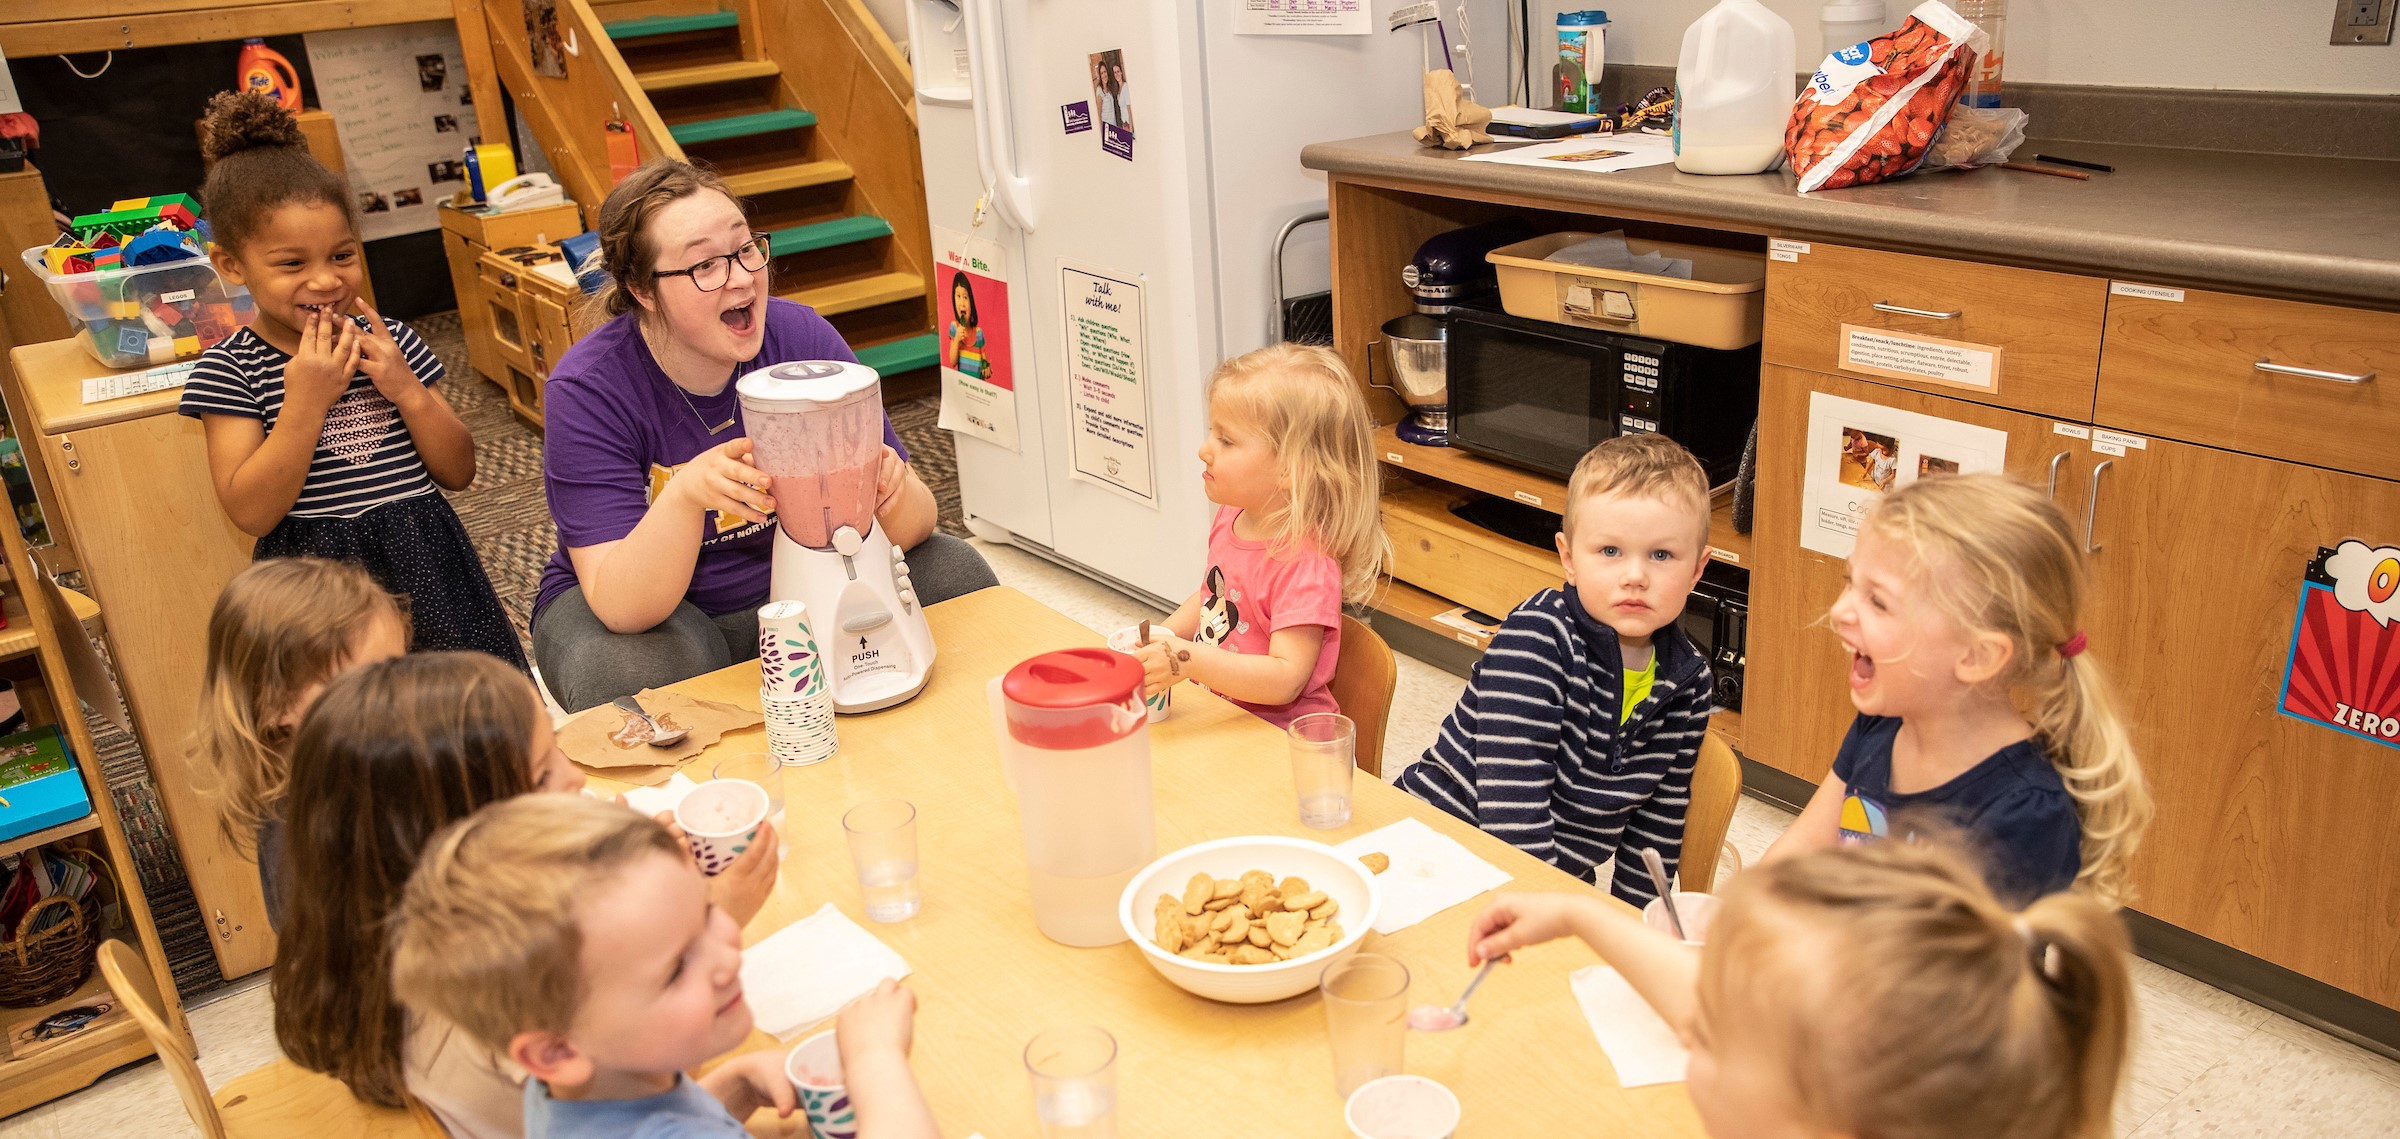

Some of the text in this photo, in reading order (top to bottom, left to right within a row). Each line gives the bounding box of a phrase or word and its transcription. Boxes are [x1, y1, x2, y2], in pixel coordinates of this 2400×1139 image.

[249, 76, 270, 88] Tide
[972, 258, 990, 272] Bite.
[1093, 282, 1112, 296] Talk
[2120, 286, 2146, 294] COOKING
[1085, 294, 1121, 313] with me!
[1852, 334, 1916, 348] Breakfast/snack/lunchtime:
[1917, 344, 1943, 354] ingredients,
[1851, 342, 1876, 351] condiments,
[1877, 346, 1899, 354] nutritious,
[1900, 350, 1929, 359] scrumptious,
[1947, 358, 1971, 366] delectable,
[1850, 357, 1875, 365] metabolism,
[1894, 364, 1927, 374] carbohydrates,
[1917, 360, 1937, 368] flatware,
[720, 516, 779, 542] OF NORTHE
[852, 650, 879, 663] PUSH
[854, 660, 878, 670] One-Touch
[2332, 702, 2400, 738] ZERO
